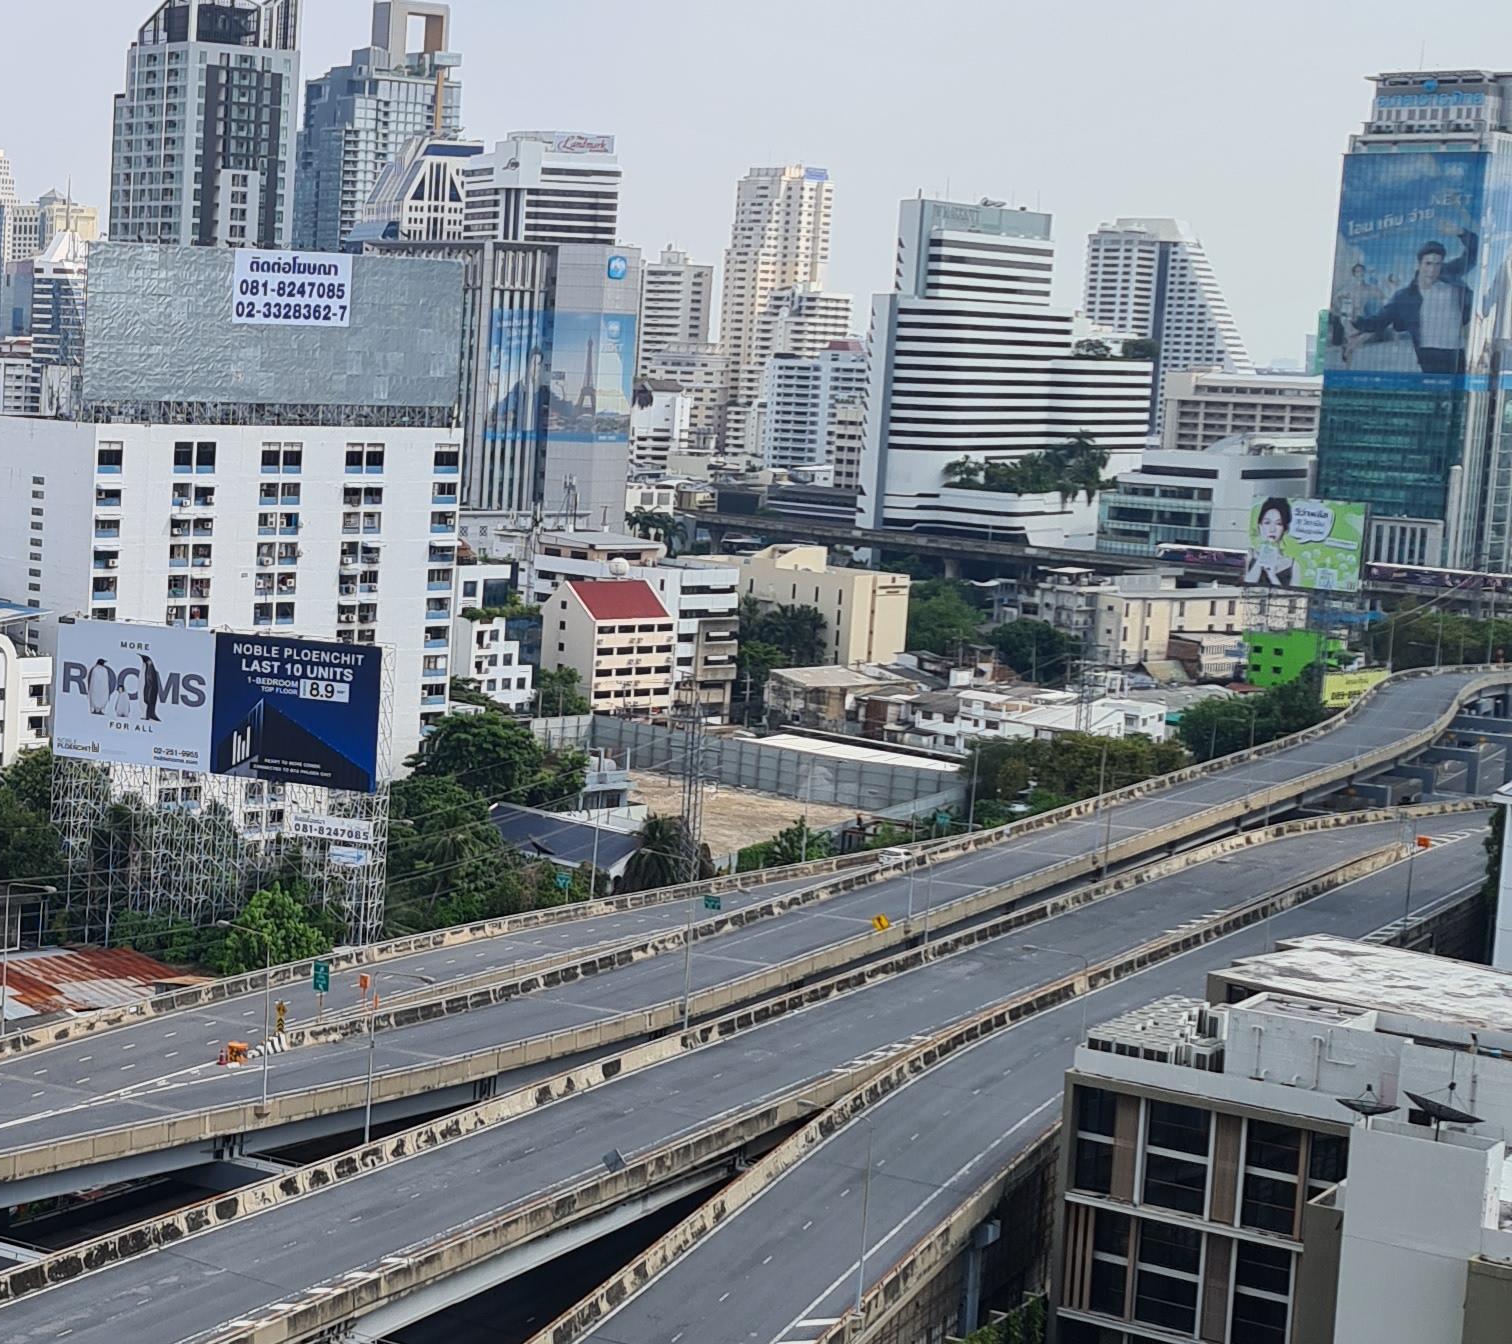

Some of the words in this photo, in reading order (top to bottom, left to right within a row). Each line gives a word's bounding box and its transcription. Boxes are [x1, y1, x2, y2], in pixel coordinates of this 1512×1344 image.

[250, 256, 338, 276] ติดต่อโฆษณา
[240, 279, 345, 299] 081-8247085
[236, 301, 347, 321] 02-3328362-7
[120, 641, 150, 651] MORE
[233, 643, 280, 658] NOBLE
[284, 647, 364, 666] PLOENCHIT
[241, 659, 280, 674] LAST
[285, 663, 302, 676] 10
[307, 666, 353, 681] UNITS
[248, 676, 298, 688] 1-BEDROOM
[309, 682, 335, 698] 8.9
[261, 685, 274, 693] TOP
[276, 687, 298, 695] FLOOR
[109, 721, 129, 731] FOR
[135, 723, 154, 733] ALL
[294, 822, 369, 841] 081-8247085
